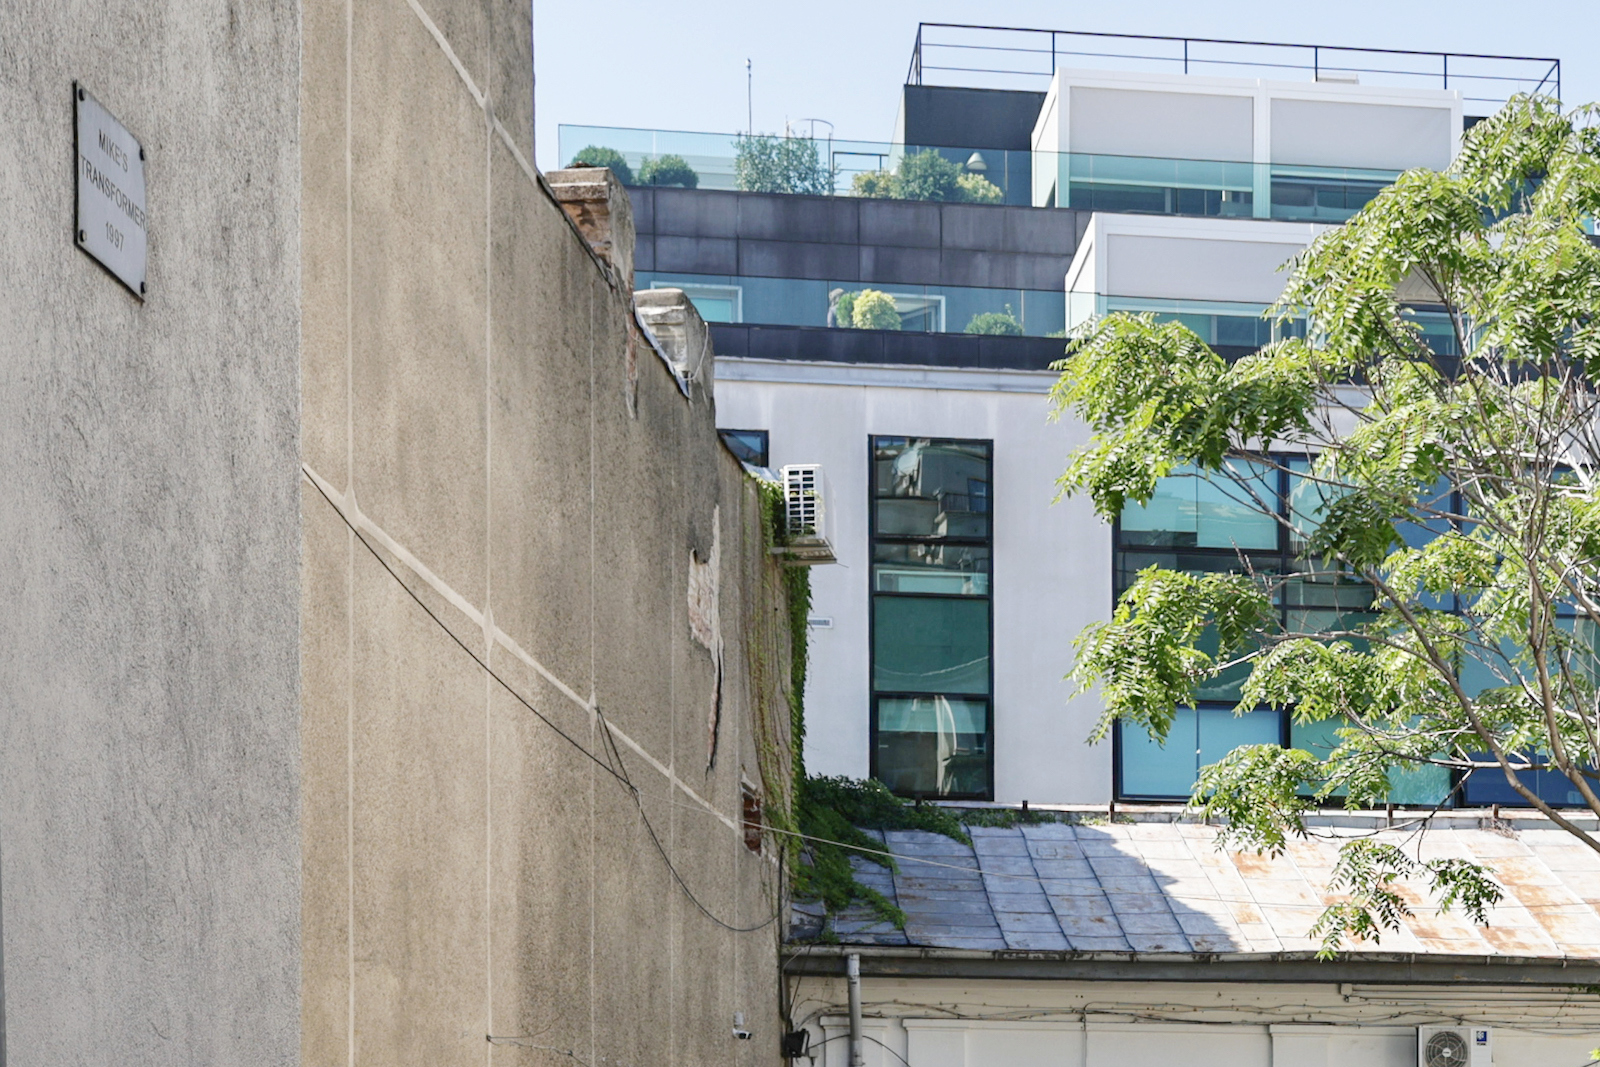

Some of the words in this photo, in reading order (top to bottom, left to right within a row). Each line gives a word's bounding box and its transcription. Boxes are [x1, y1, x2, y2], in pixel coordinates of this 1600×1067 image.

[98, 128, 128, 173] MIKE'S
[80, 154, 146, 232] TRANSFORMER
[105, 221, 124, 252] 1997
